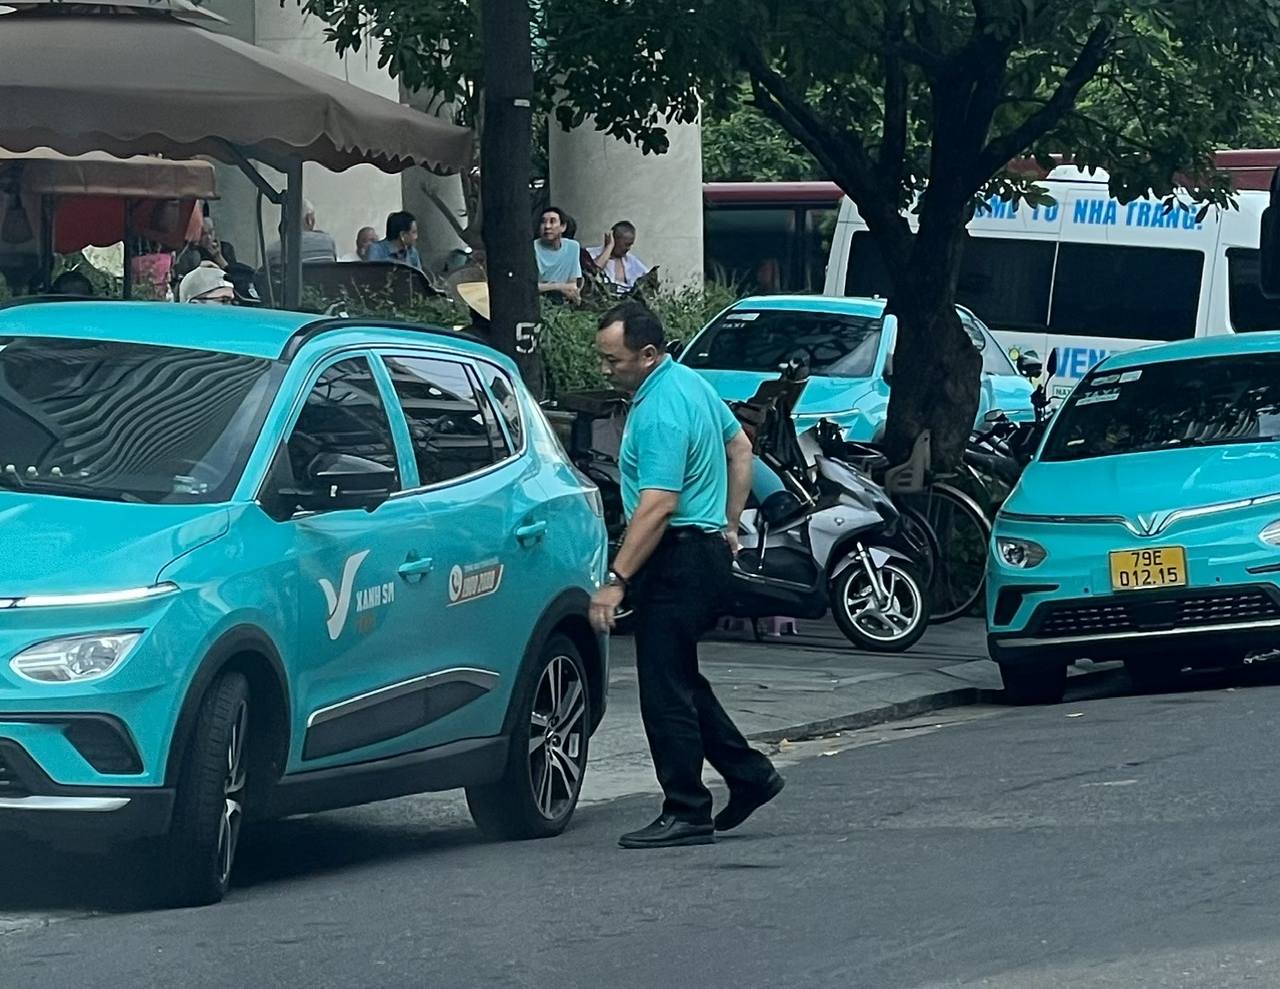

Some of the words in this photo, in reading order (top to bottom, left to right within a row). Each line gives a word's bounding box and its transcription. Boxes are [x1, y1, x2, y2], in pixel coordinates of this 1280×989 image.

[1073, 198, 1117, 225] NHA
[1131, 550, 1163, 567] 79E
[1120, 567, 1178, 587] 012.15
[356, 585, 381, 612] XANH
[382, 581, 395, 604] SM
